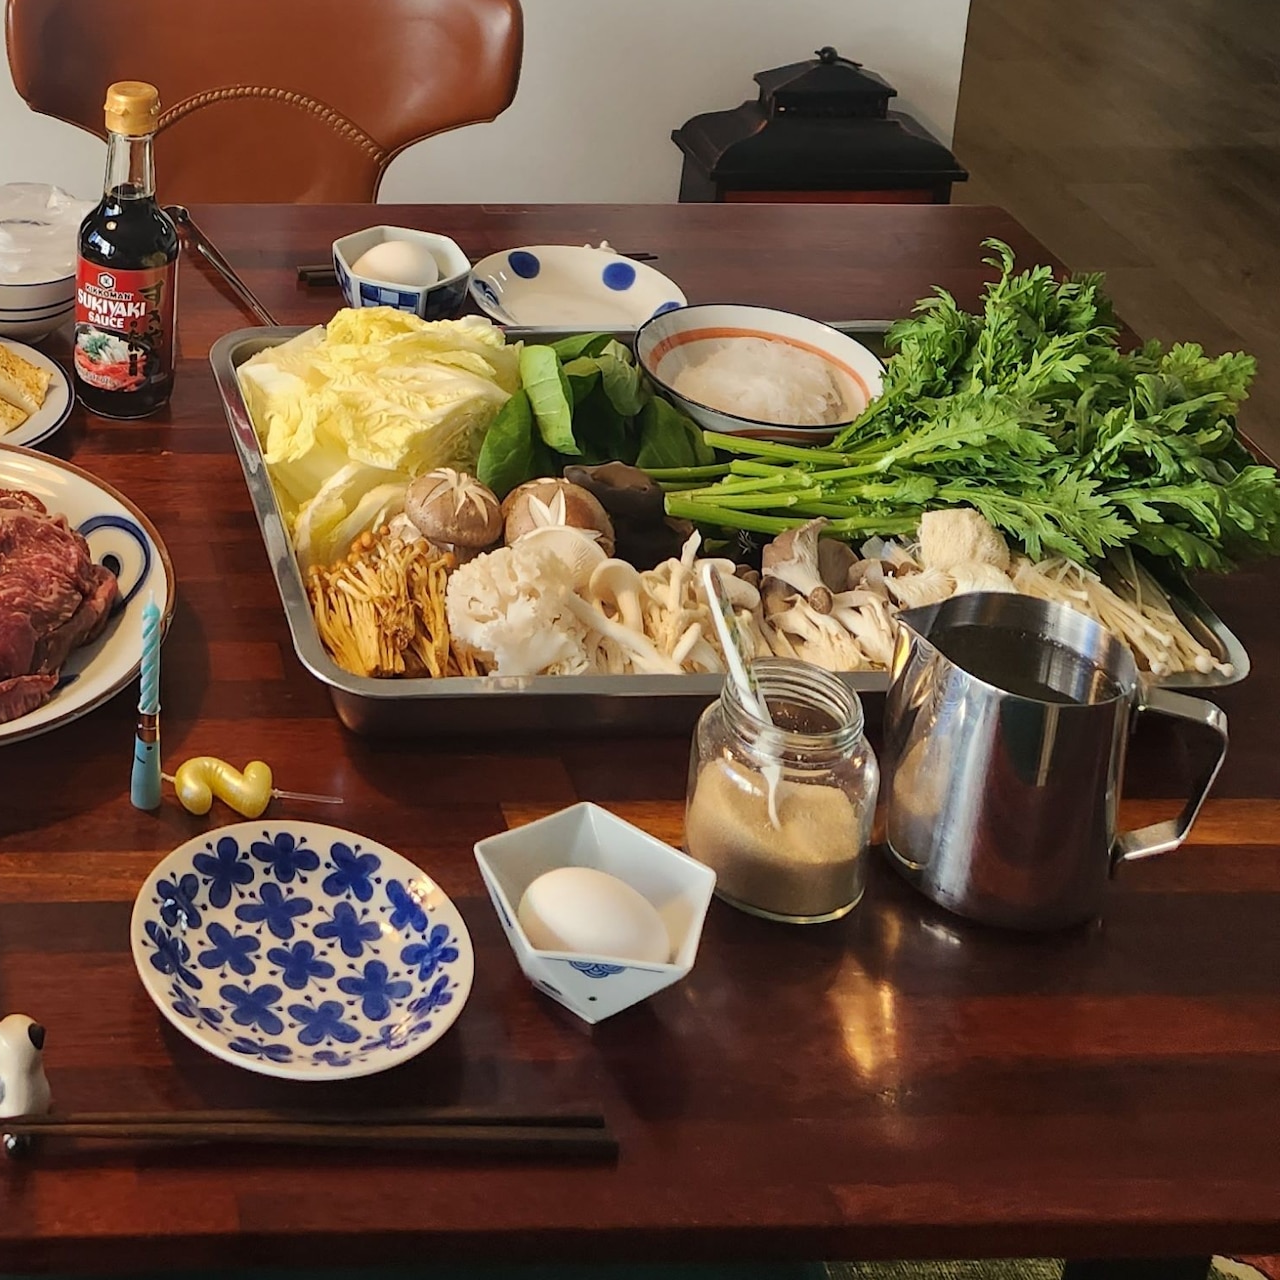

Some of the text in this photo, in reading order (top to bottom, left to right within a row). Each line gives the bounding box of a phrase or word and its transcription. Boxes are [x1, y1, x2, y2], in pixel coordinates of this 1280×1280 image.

[86, 285, 131, 300] KIKKOMAN
[77, 287, 146, 318] SUKIYAKI
[87, 311, 125, 329] SAUCE
